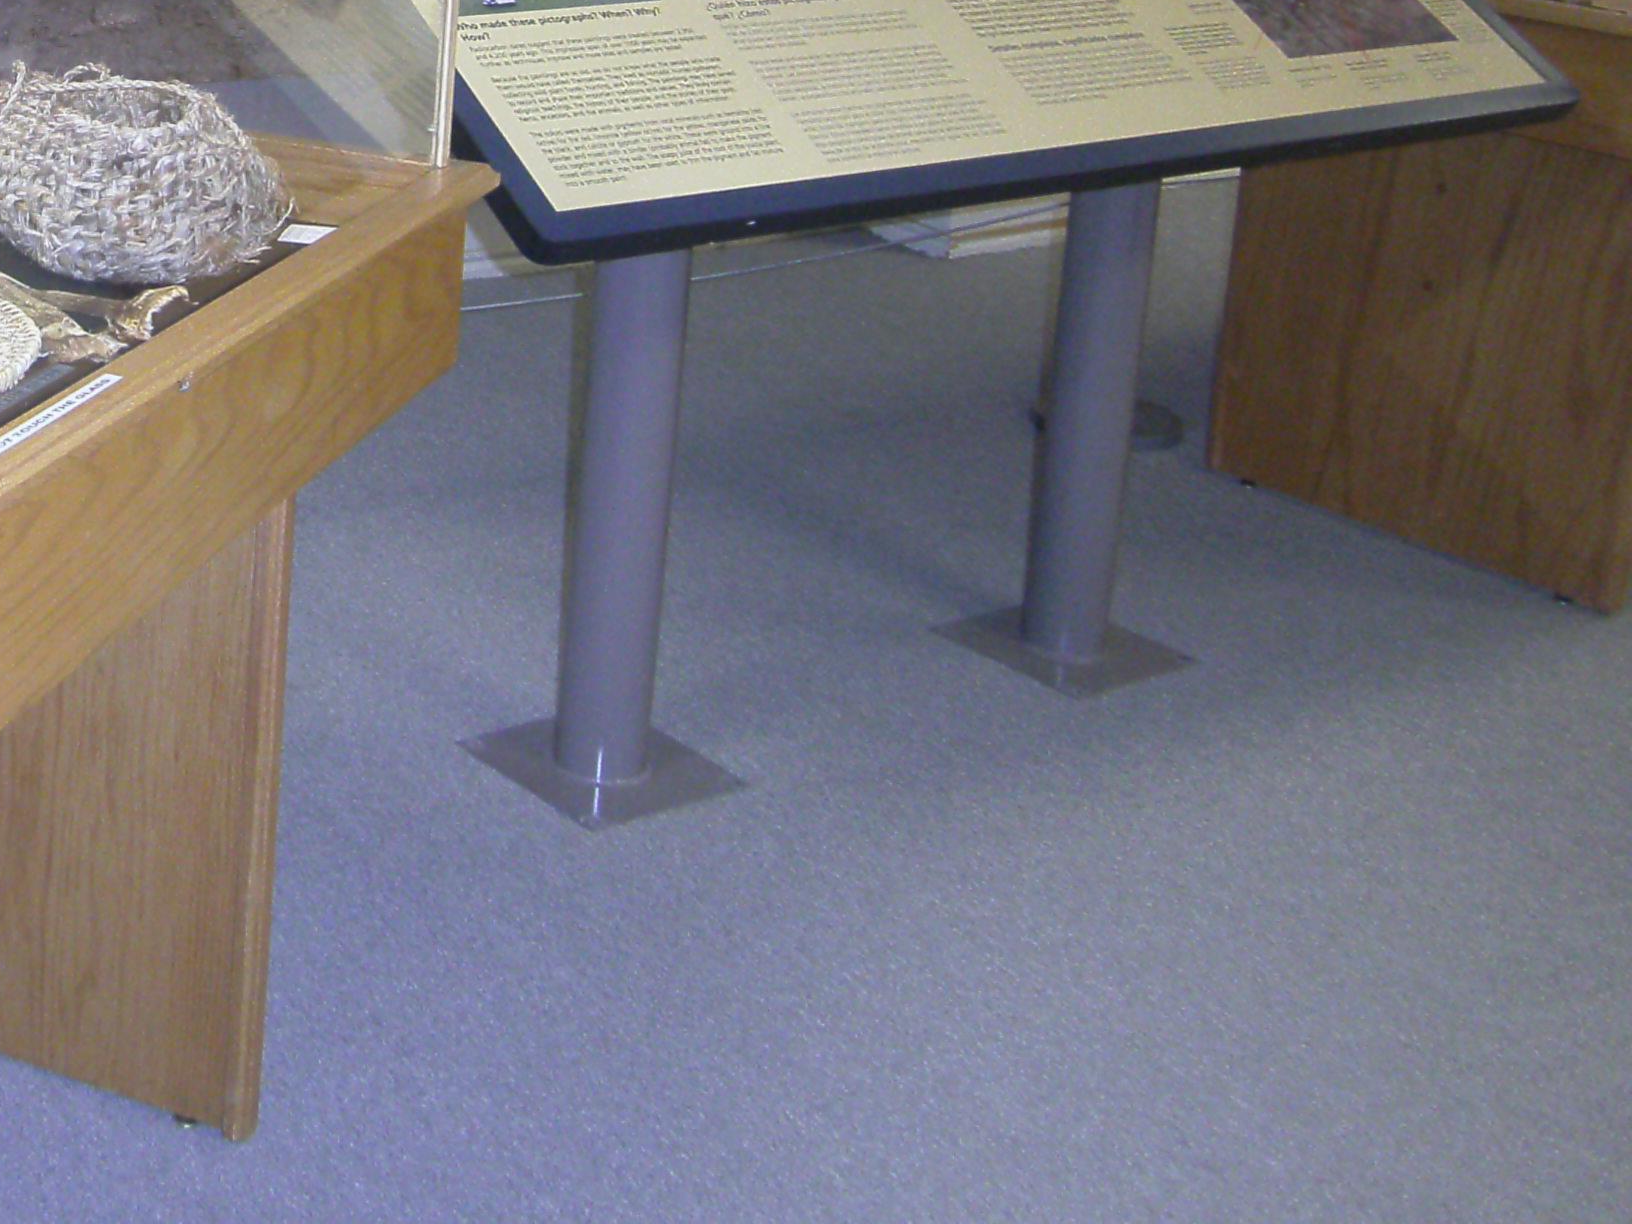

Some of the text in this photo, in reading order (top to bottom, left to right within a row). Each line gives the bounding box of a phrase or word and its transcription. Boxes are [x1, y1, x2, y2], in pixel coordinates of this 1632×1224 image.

[479, 19, 508, 30] made
[508, 17, 537, 27] these
[538, 12, 598, 26] pictographs?
[598, 9, 633, 19] When?
[634, 6, 661, 17] Why?
[461, 31, 490, 42] How?
[13, 412, 54, 438] TOUCH
[51, 397, 78, 417] THE
[75, 378, 112, 402] GLASS
